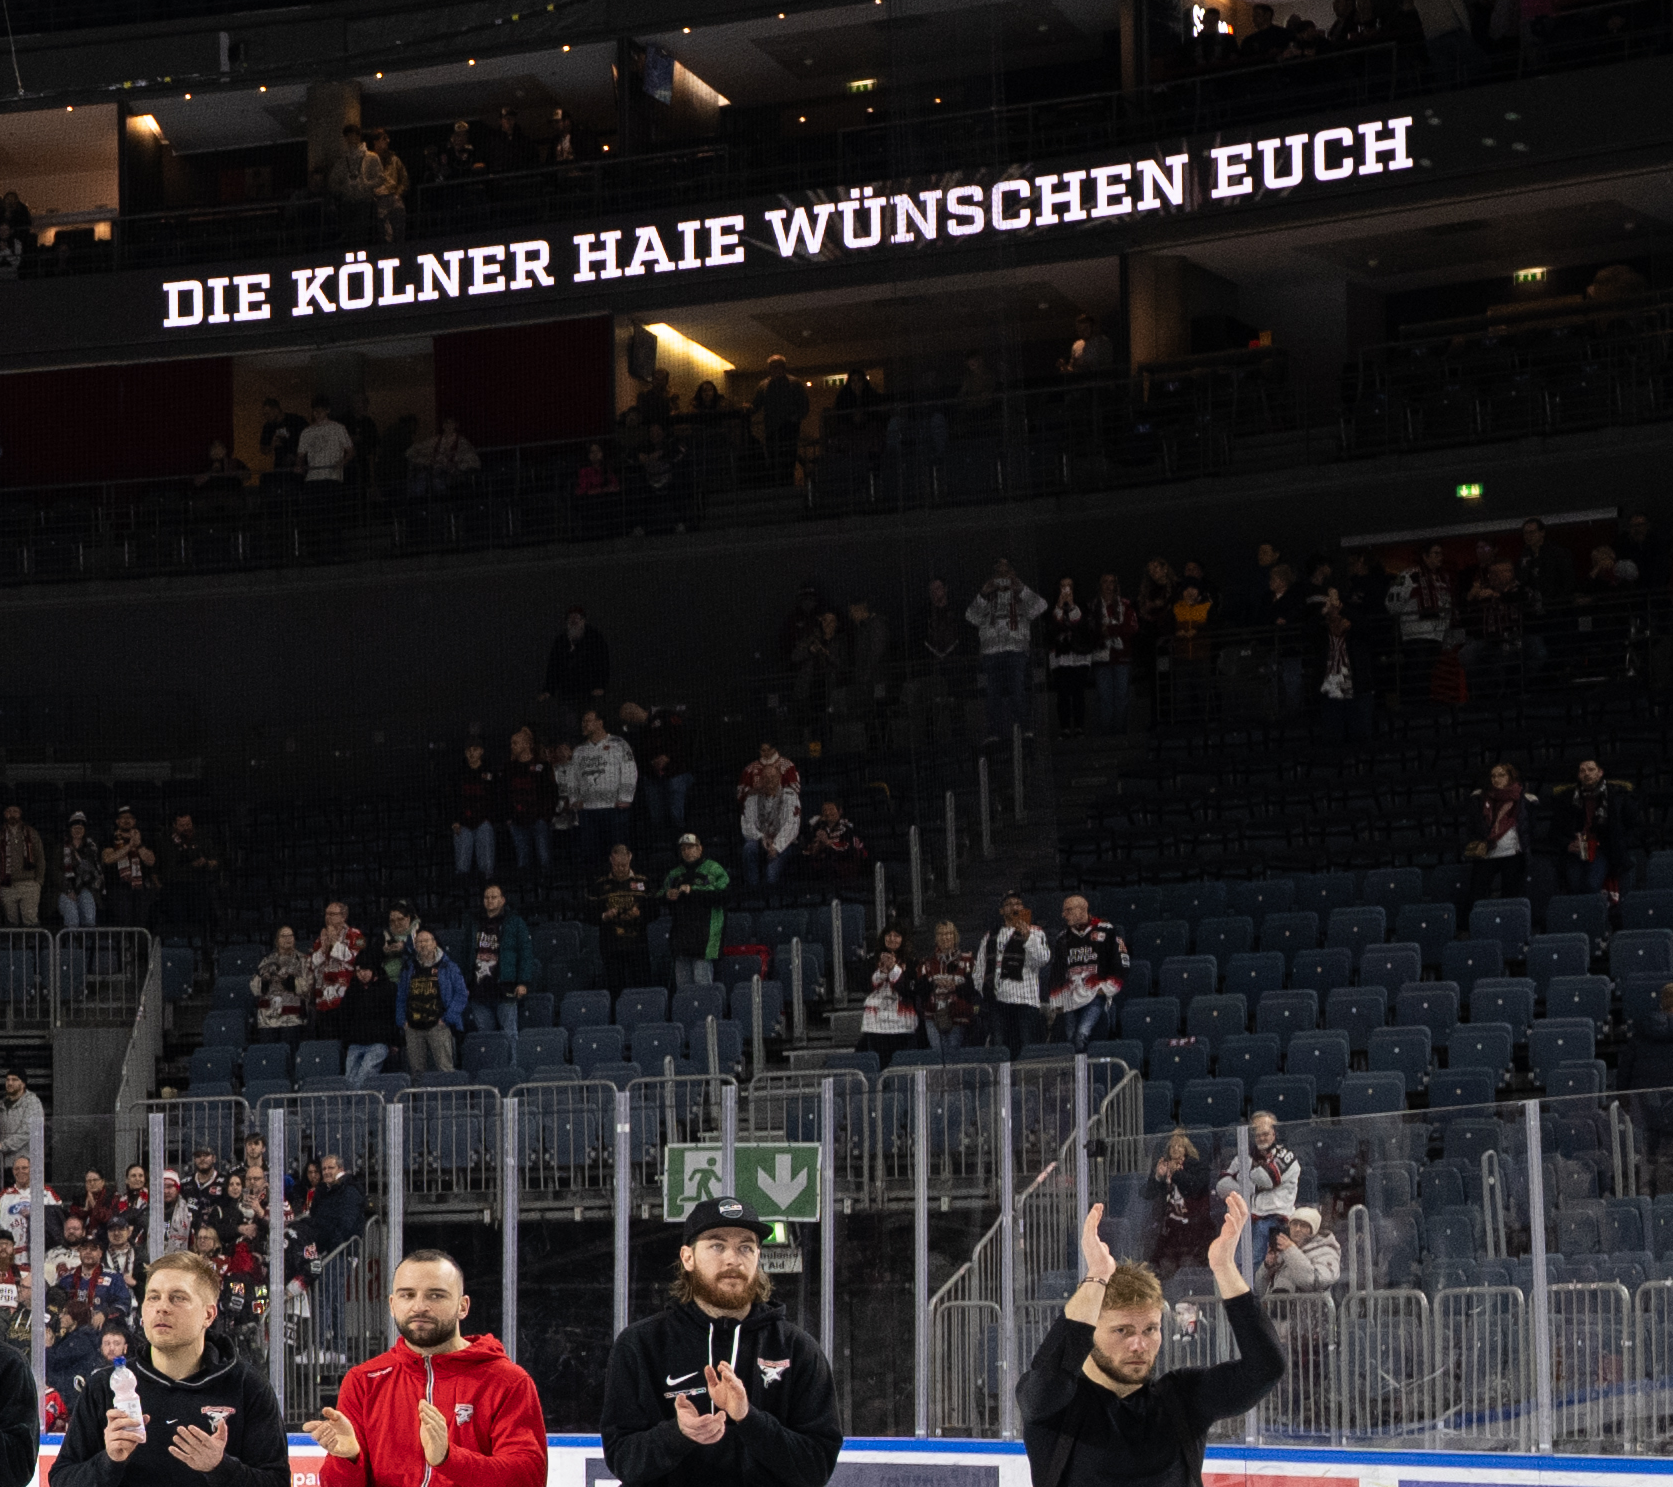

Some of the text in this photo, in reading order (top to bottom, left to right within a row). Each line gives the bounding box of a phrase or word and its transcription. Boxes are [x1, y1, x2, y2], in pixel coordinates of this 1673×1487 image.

[163, 117, 1412, 327] DIE KÖLNER HAIE WÜNSCHEN EUCH
